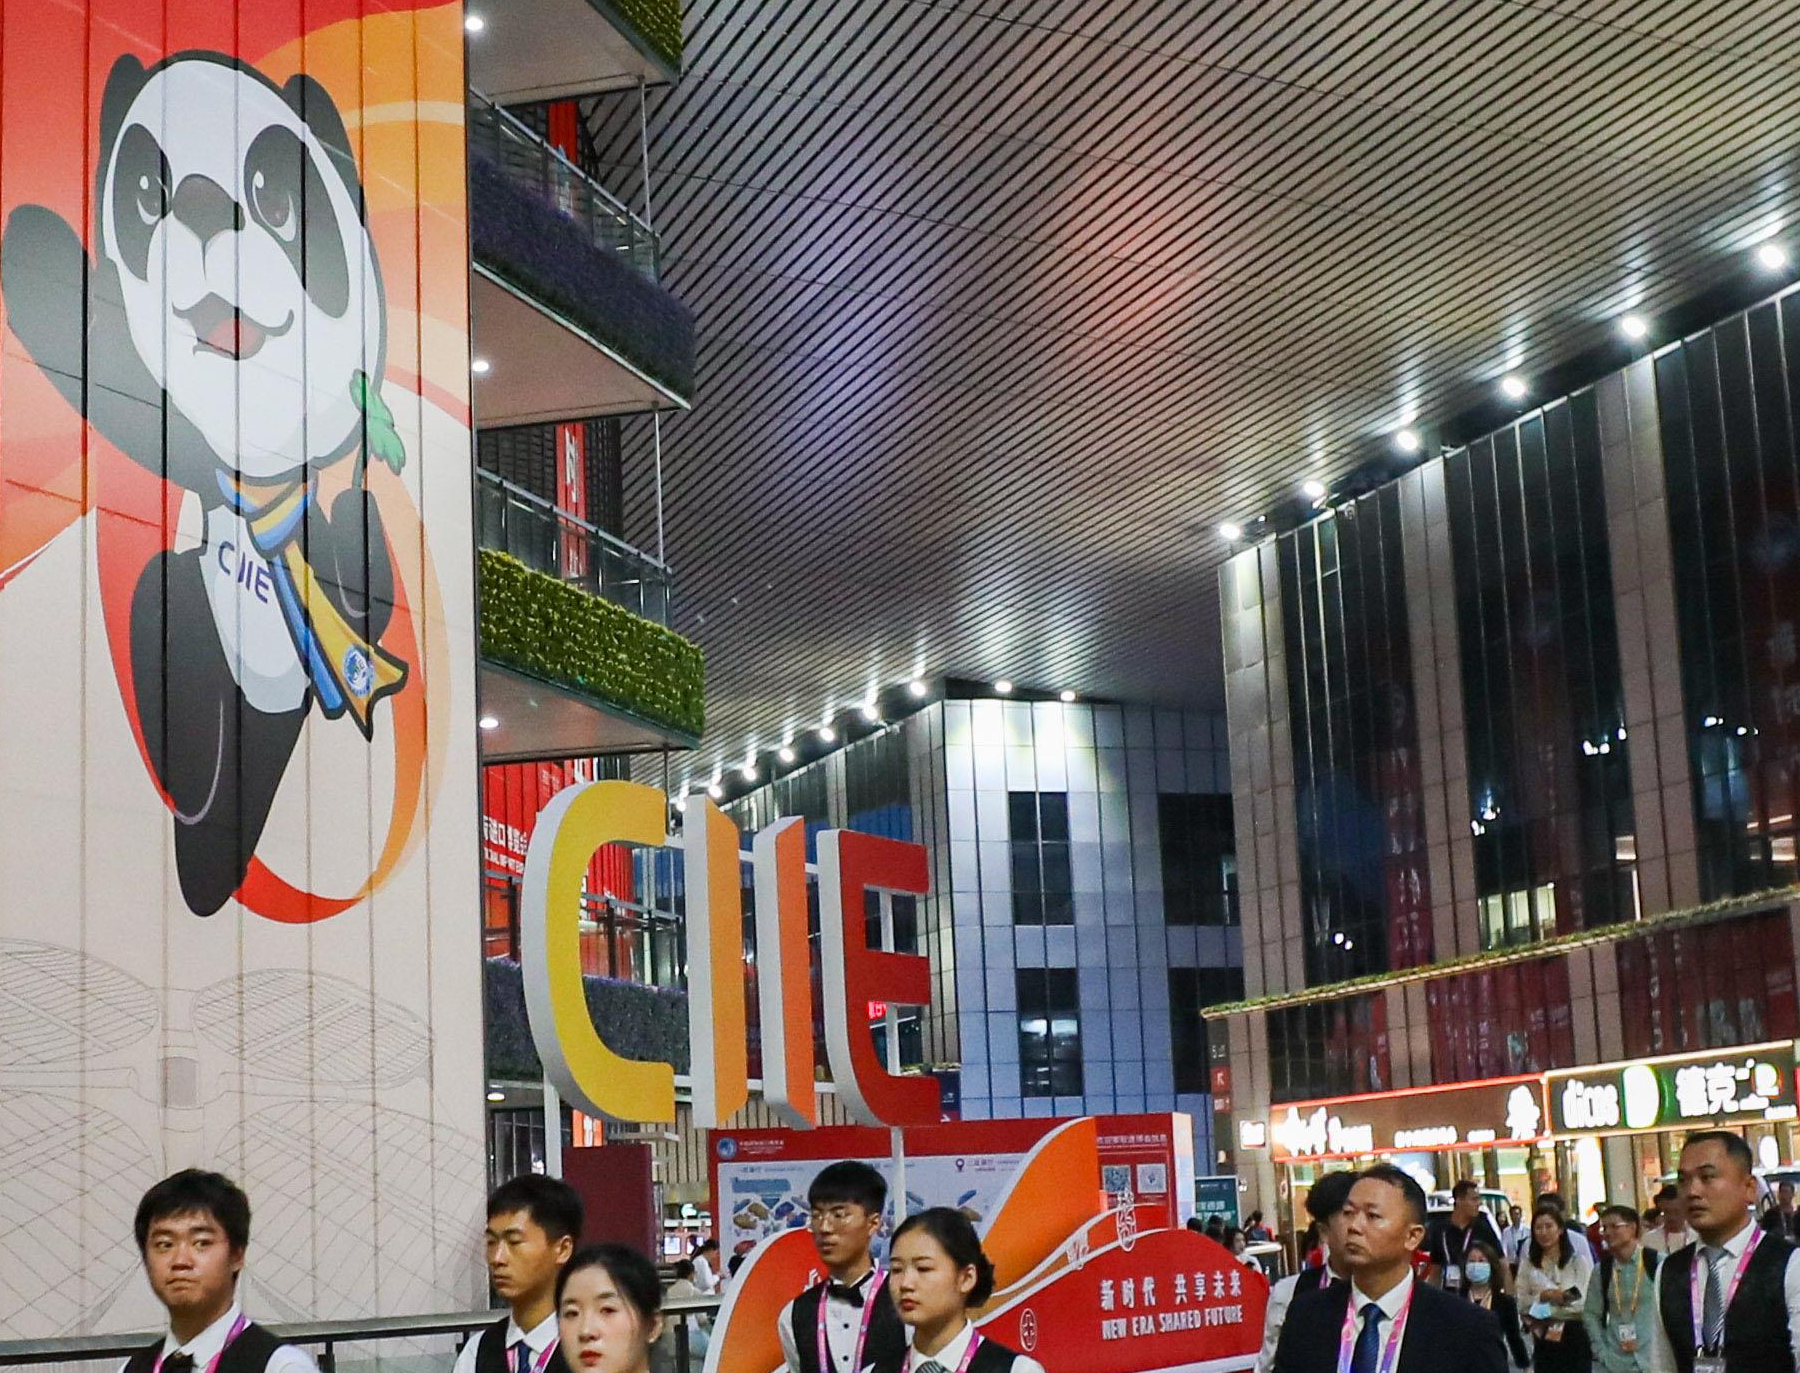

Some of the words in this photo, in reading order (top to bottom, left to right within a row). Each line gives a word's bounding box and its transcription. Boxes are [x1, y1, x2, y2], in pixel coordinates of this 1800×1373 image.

[217, 540, 273, 604] CIIE
[521, 778, 941, 1130] CIIE
[1100, 1277, 1157, 1312] 新时代
[1174, 1268, 1242, 1306] 共享未来
[1101, 1317, 1128, 1341] NEW
[1132, 1314, 1156, 1337] ERA
[1159, 1309, 1201, 1333] SHARED
[1205, 1304, 1244, 1327] FUTURE
